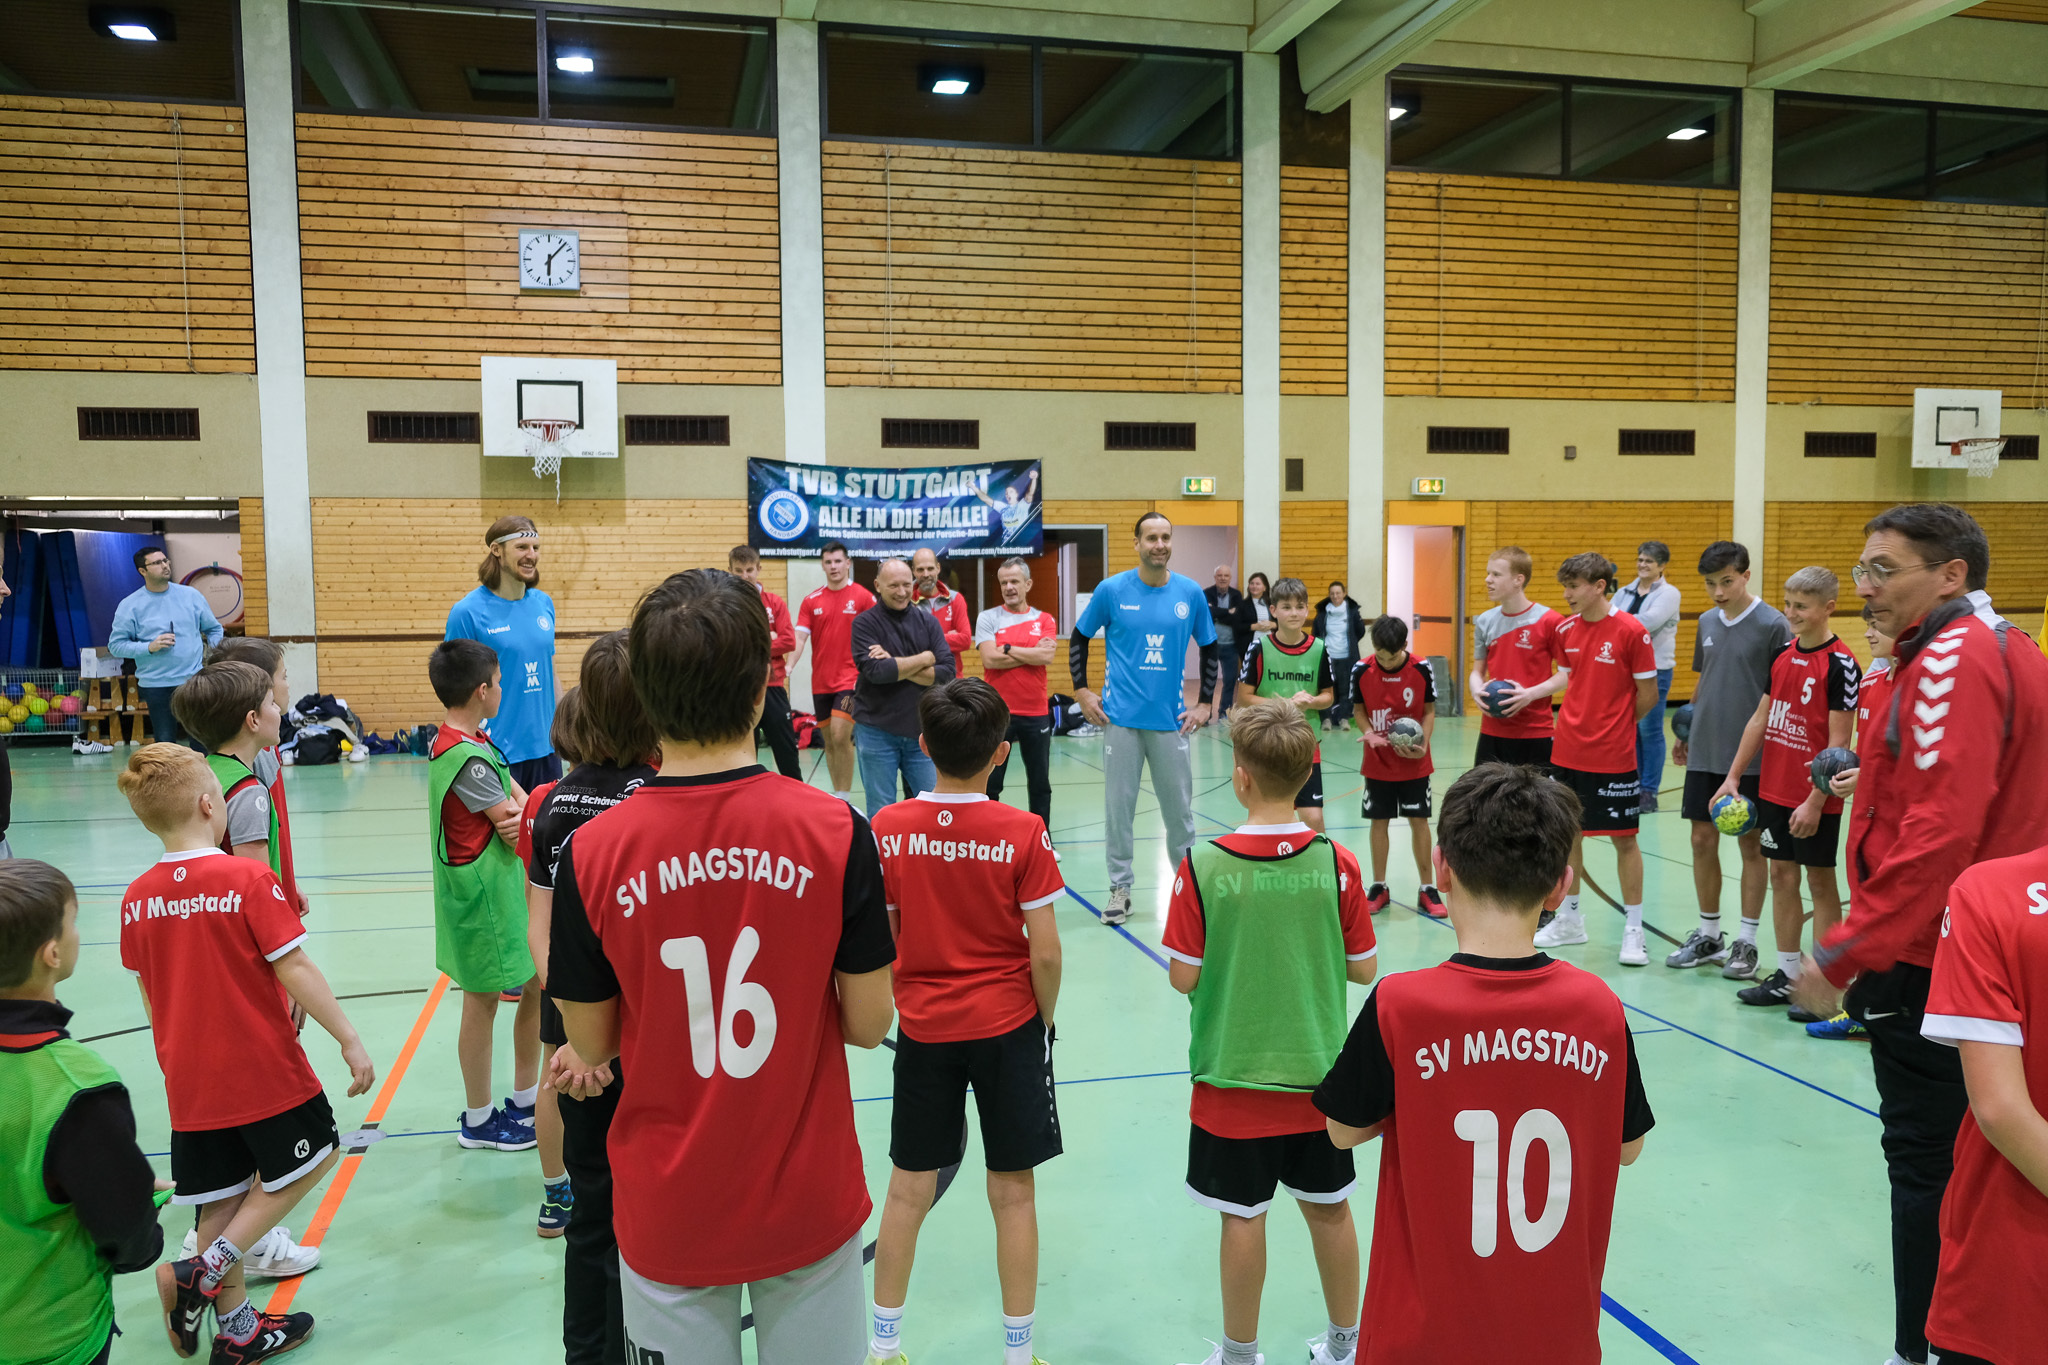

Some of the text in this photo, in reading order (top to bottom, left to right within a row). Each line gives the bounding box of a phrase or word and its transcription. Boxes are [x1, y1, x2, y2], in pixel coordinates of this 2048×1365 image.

[785, 466, 992, 500] TVB STUTTGART
[818, 505, 988, 529] ALLE IN DIE HALLE!
[769, 527, 801, 538] HANDBALL
[818, 528, 989, 540] Erlebe Spitzenhandball live in der Porsche-Arena
[759, 547, 821, 559] www.tvbstuttgart.d
[1145, 634, 1164, 647] W
[524, 661, 538, 674] W
[1144, 651, 1163, 664] M
[527, 675, 540, 687] M
[1268, 668, 1314, 682] hummel
[1403, 687, 1413, 708] 9
[1800, 677, 1816, 705] 5
[1784, 718, 1807, 737] Nas
[881, 833, 1015, 864] SV Magstadt
[615, 847, 814, 918] SV MAGSTADT
[1214, 871, 1243, 898] SV
[124, 889, 242, 926] SV Magstadt
[2026, 881, 2048, 915] S
[659, 925, 778, 1079] 16
[1415, 1028, 1609, 1082] SV MAGSTADT
[1453, 1108, 1573, 1258] 10
[214, 1238, 239, 1265] Kemp
[1006, 1327, 1031, 1343] NIKE
